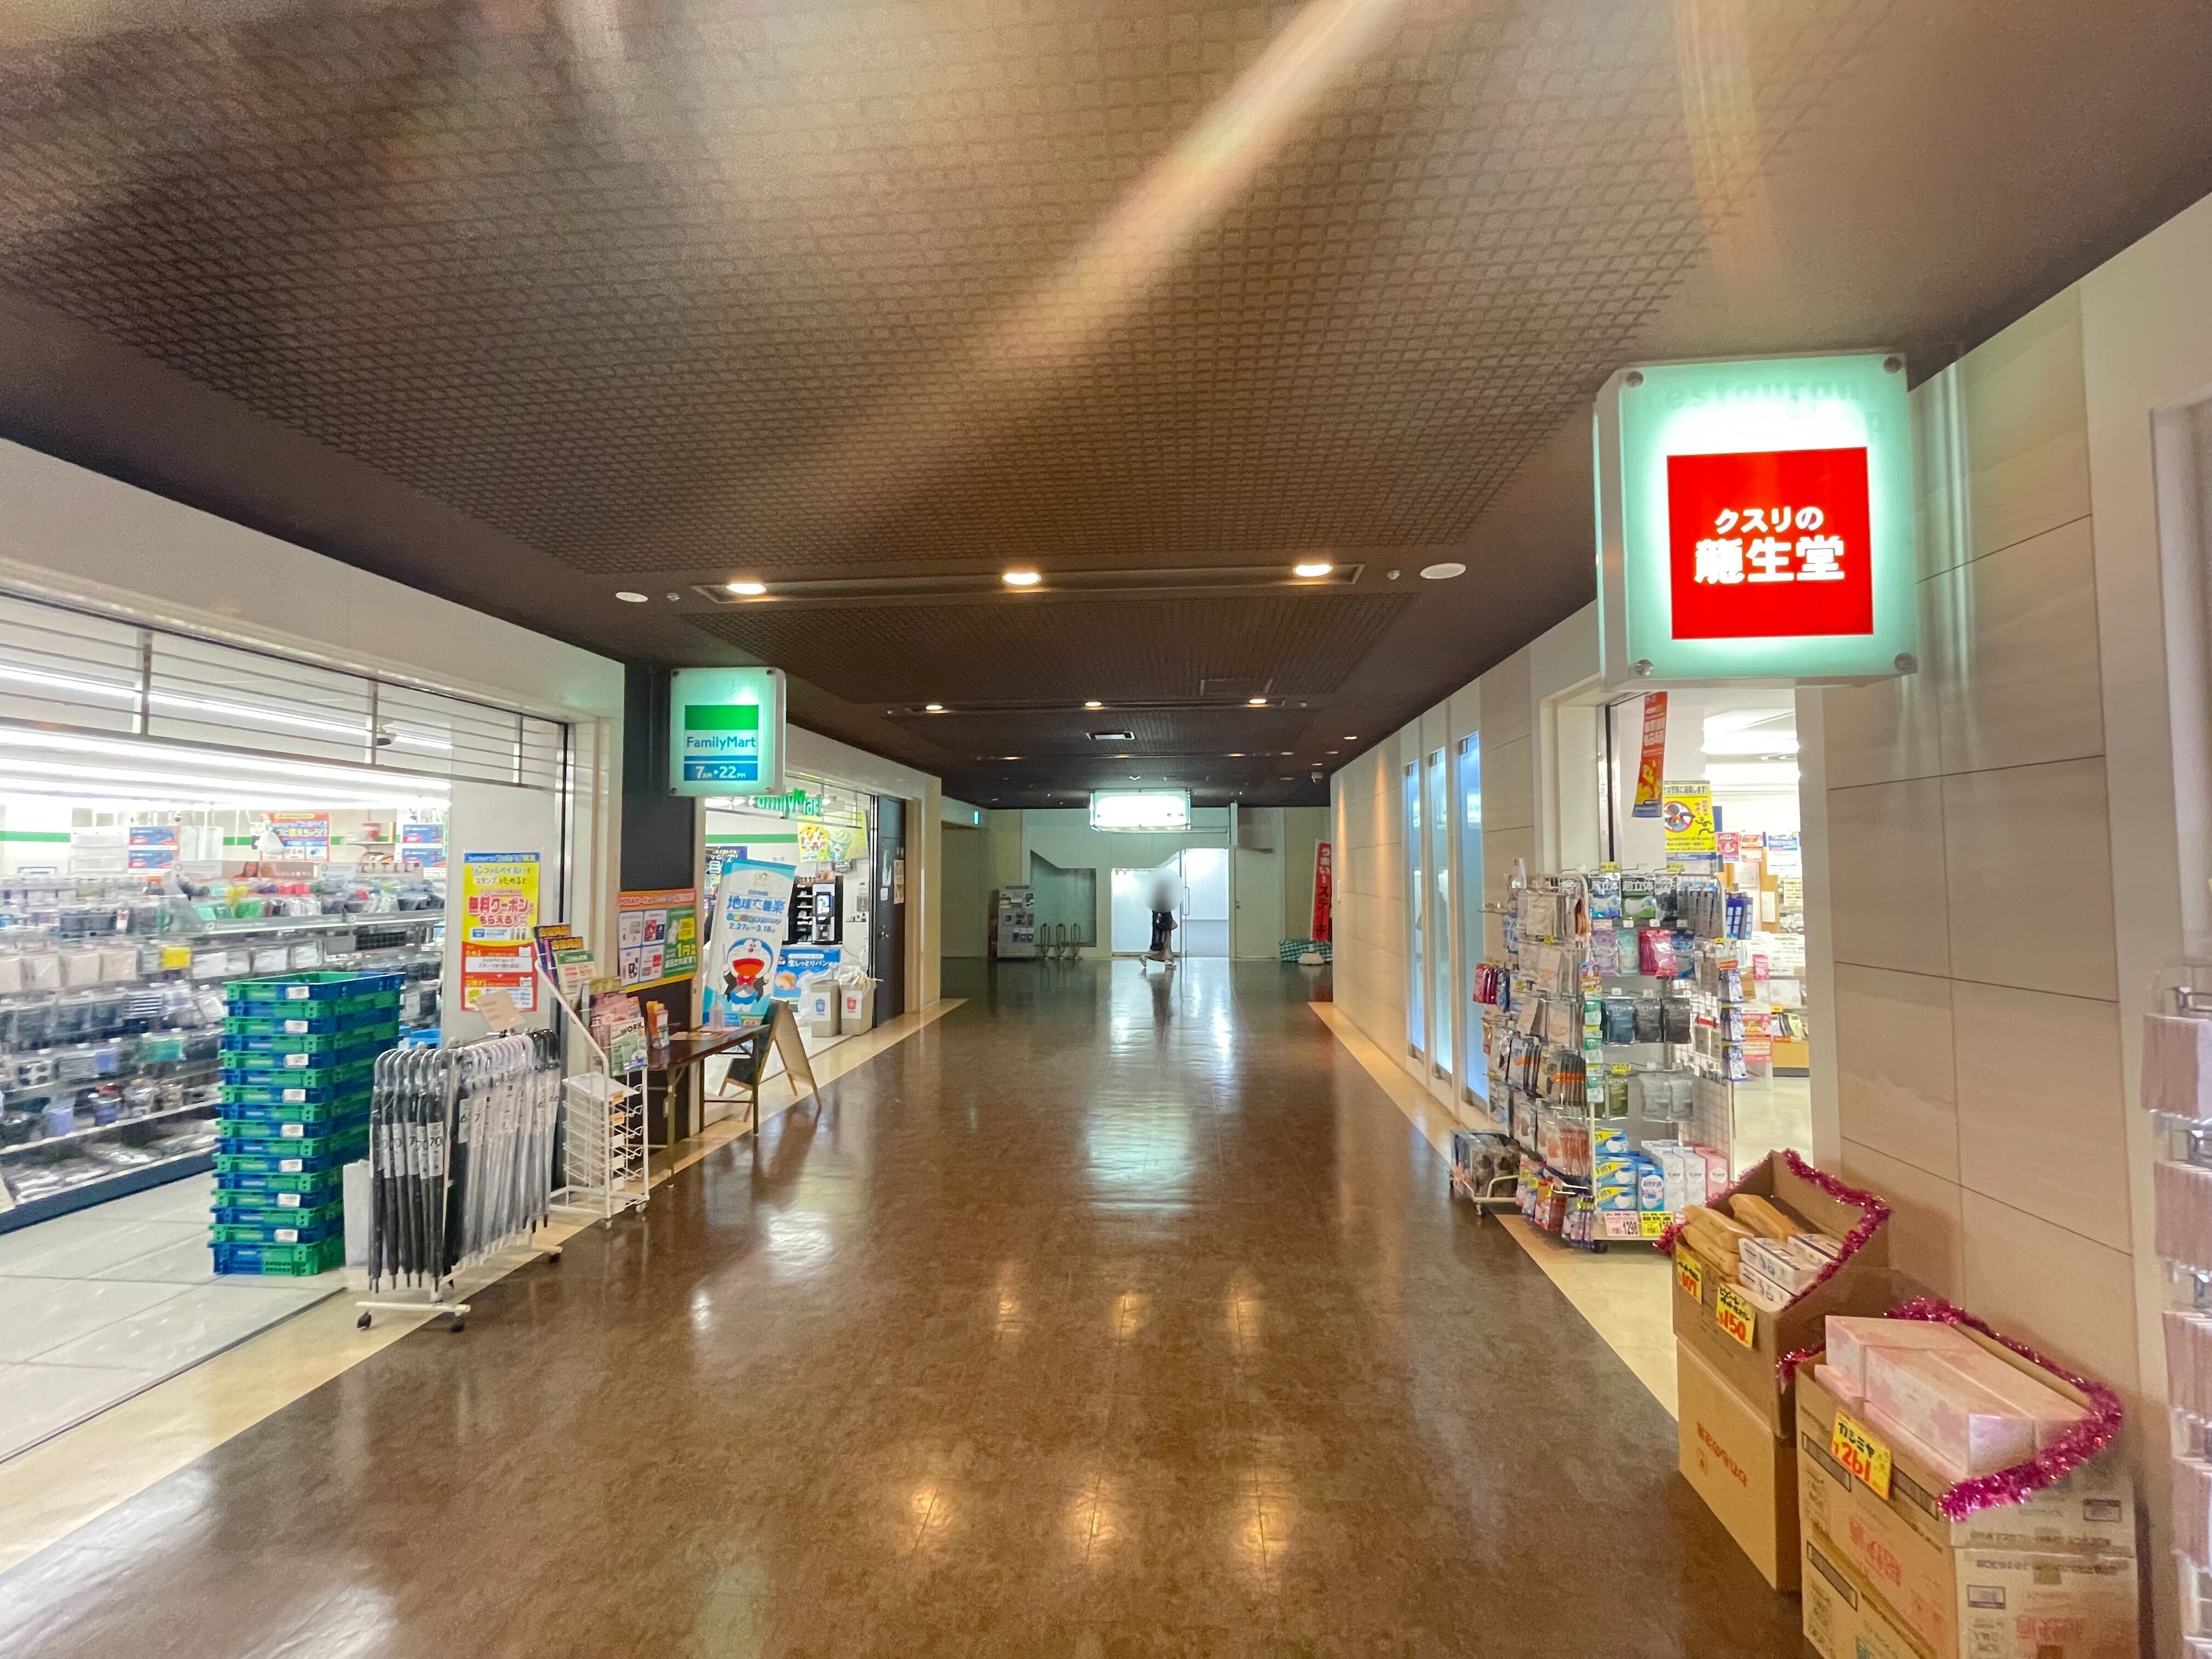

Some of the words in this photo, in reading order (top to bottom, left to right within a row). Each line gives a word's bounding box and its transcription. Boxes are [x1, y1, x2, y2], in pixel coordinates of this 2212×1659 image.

[1714, 506, 1824, 534] クスリの
[686, 736, 756, 751] FamilyMart
